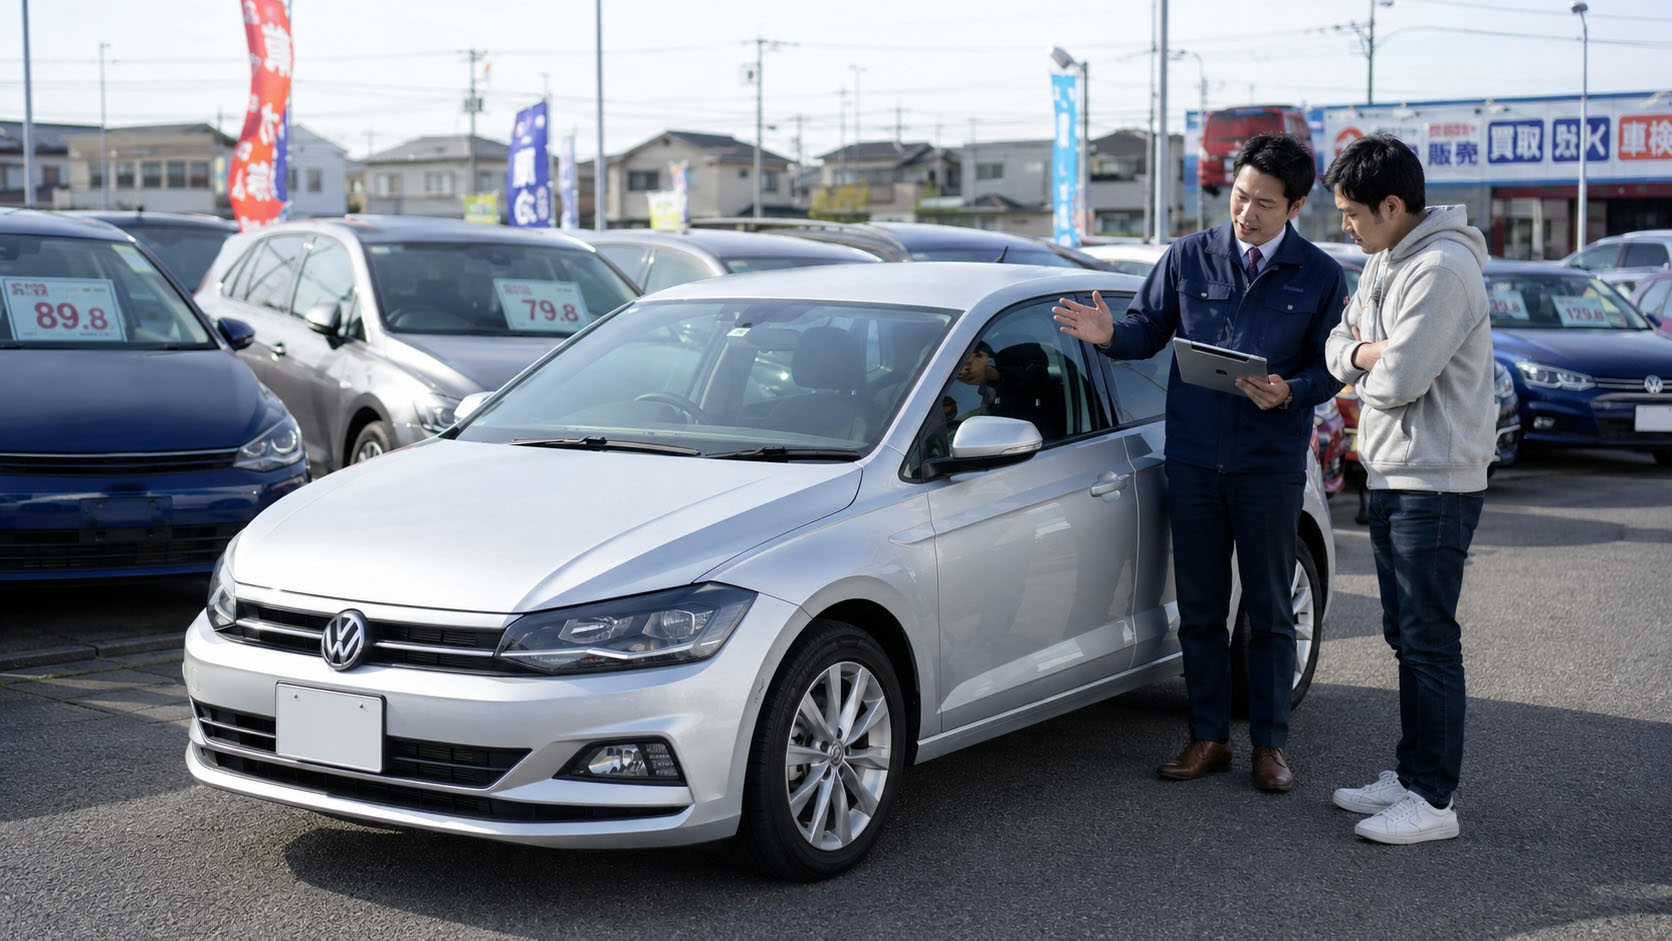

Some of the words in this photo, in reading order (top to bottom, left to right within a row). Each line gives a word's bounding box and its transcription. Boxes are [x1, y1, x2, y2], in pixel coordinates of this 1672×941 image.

[1490, 125, 1541, 160] 買取
[1619, 119, 1672, 157] 車検
[1428, 141, 1478, 166] 販売
[34, 301, 108, 330] 89.8
[521, 298, 579, 322] 79.8
